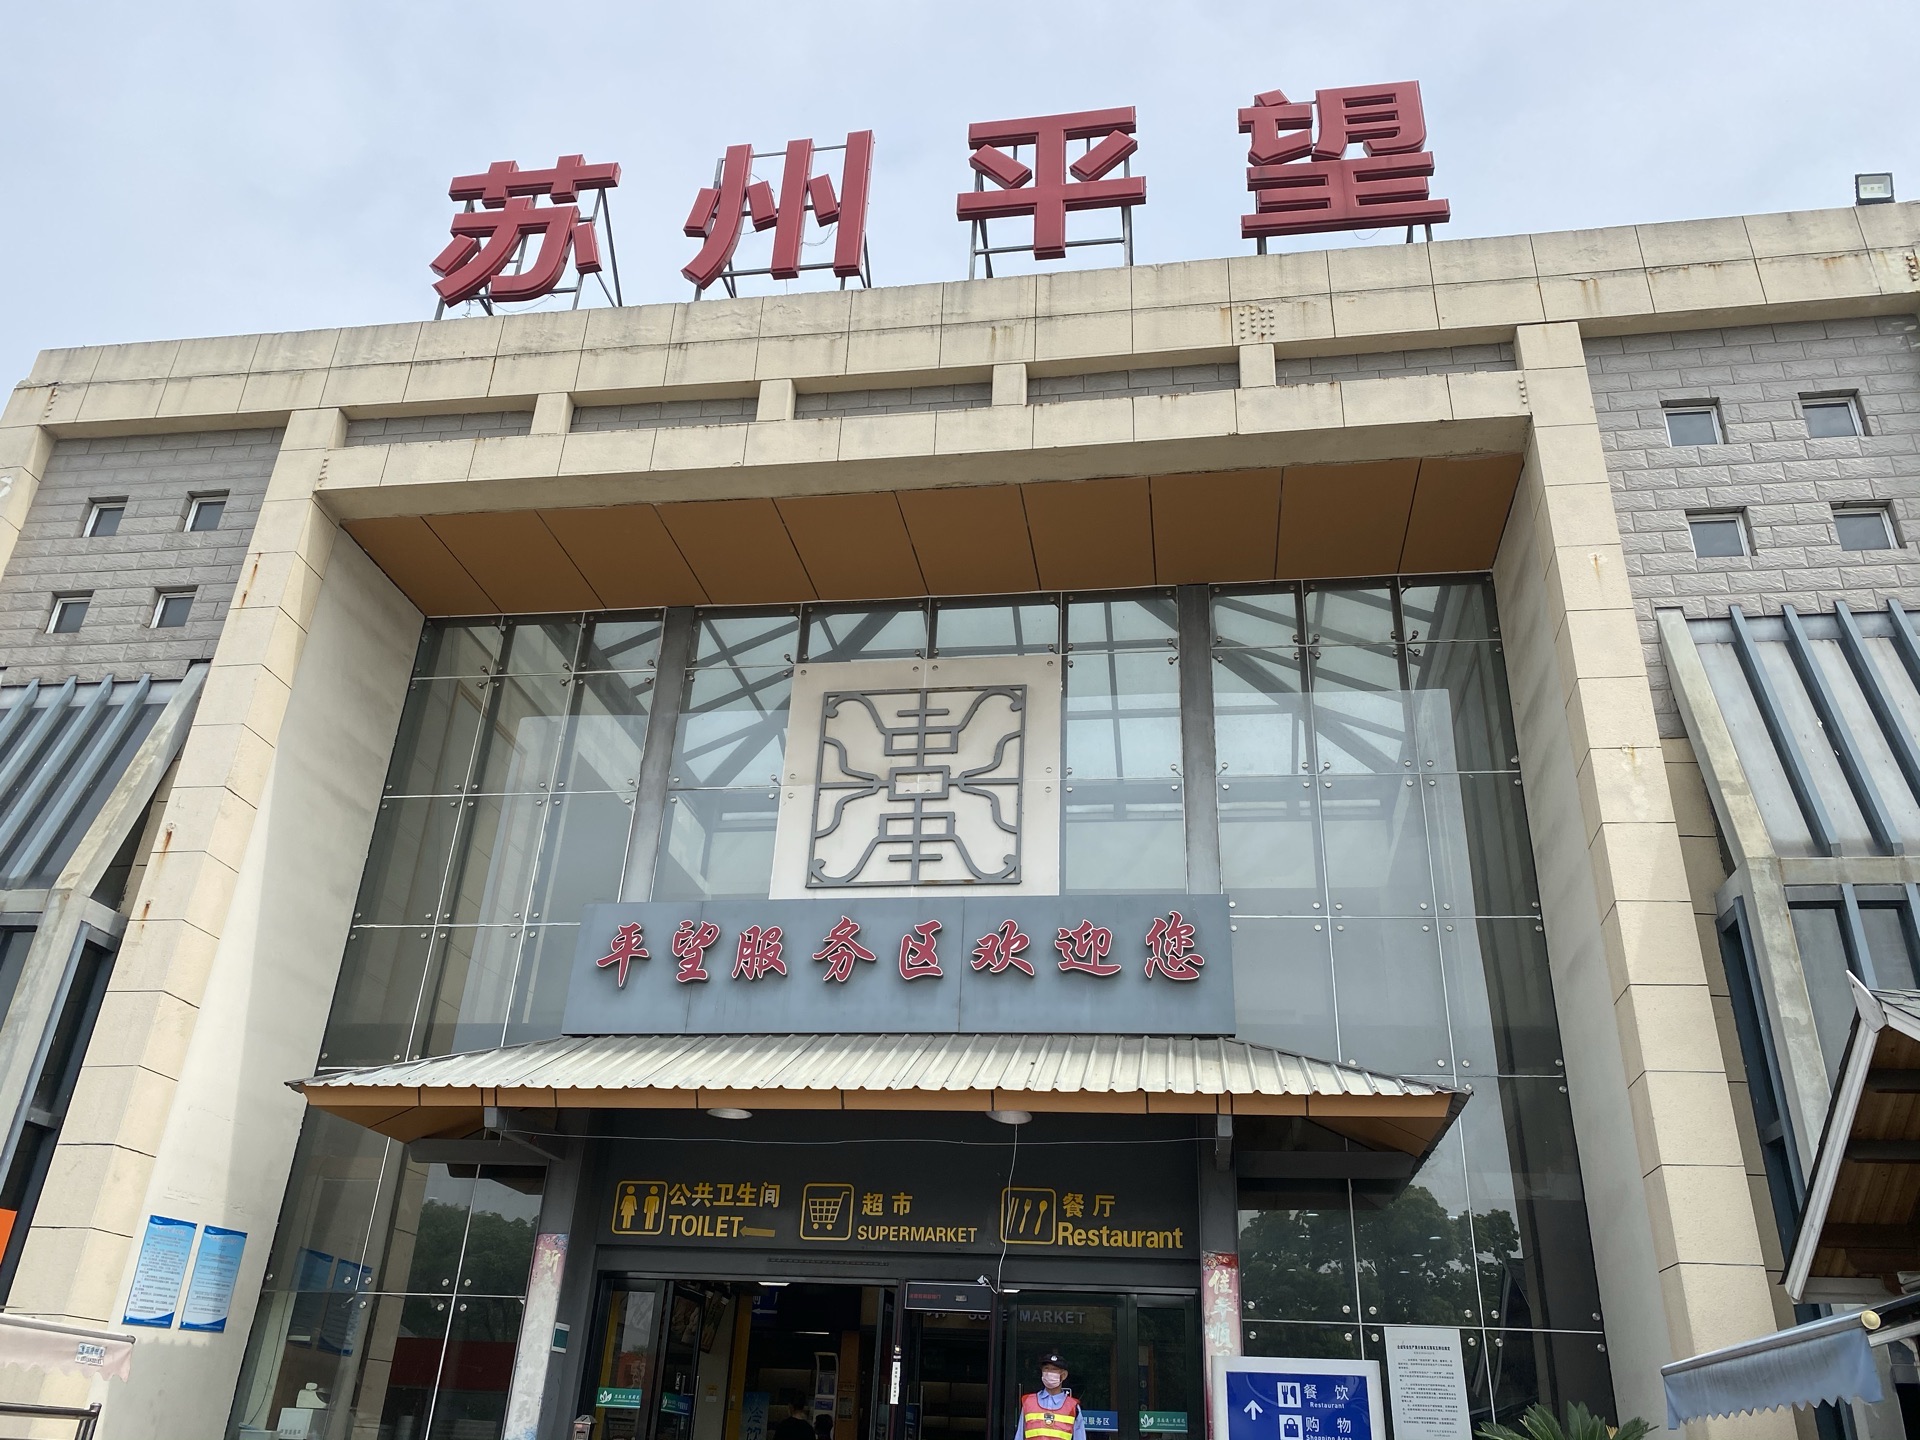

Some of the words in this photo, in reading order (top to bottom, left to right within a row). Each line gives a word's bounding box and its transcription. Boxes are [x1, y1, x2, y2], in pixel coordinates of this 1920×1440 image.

[431, 81, 1450, 304] 苏州平望
[596, 910, 1206, 988] 平望服务区欢迎您
[668, 1181, 781, 1208] 公共卫生间
[861, 1192, 913, 1216] 超市
[1062, 1192, 1116, 1218] 餐厅
[668, 1214, 744, 1238] TOILET
[857, 1225, 978, 1243] SUPERMARKET
[1057, 1221, 1184, 1249] Restaurant
[1303, 1383, 1350, 1401] 餐饮
[1309, 1401, 1345, 1409] Restaurant
[1305, 1416, 1352, 1434] 购物
